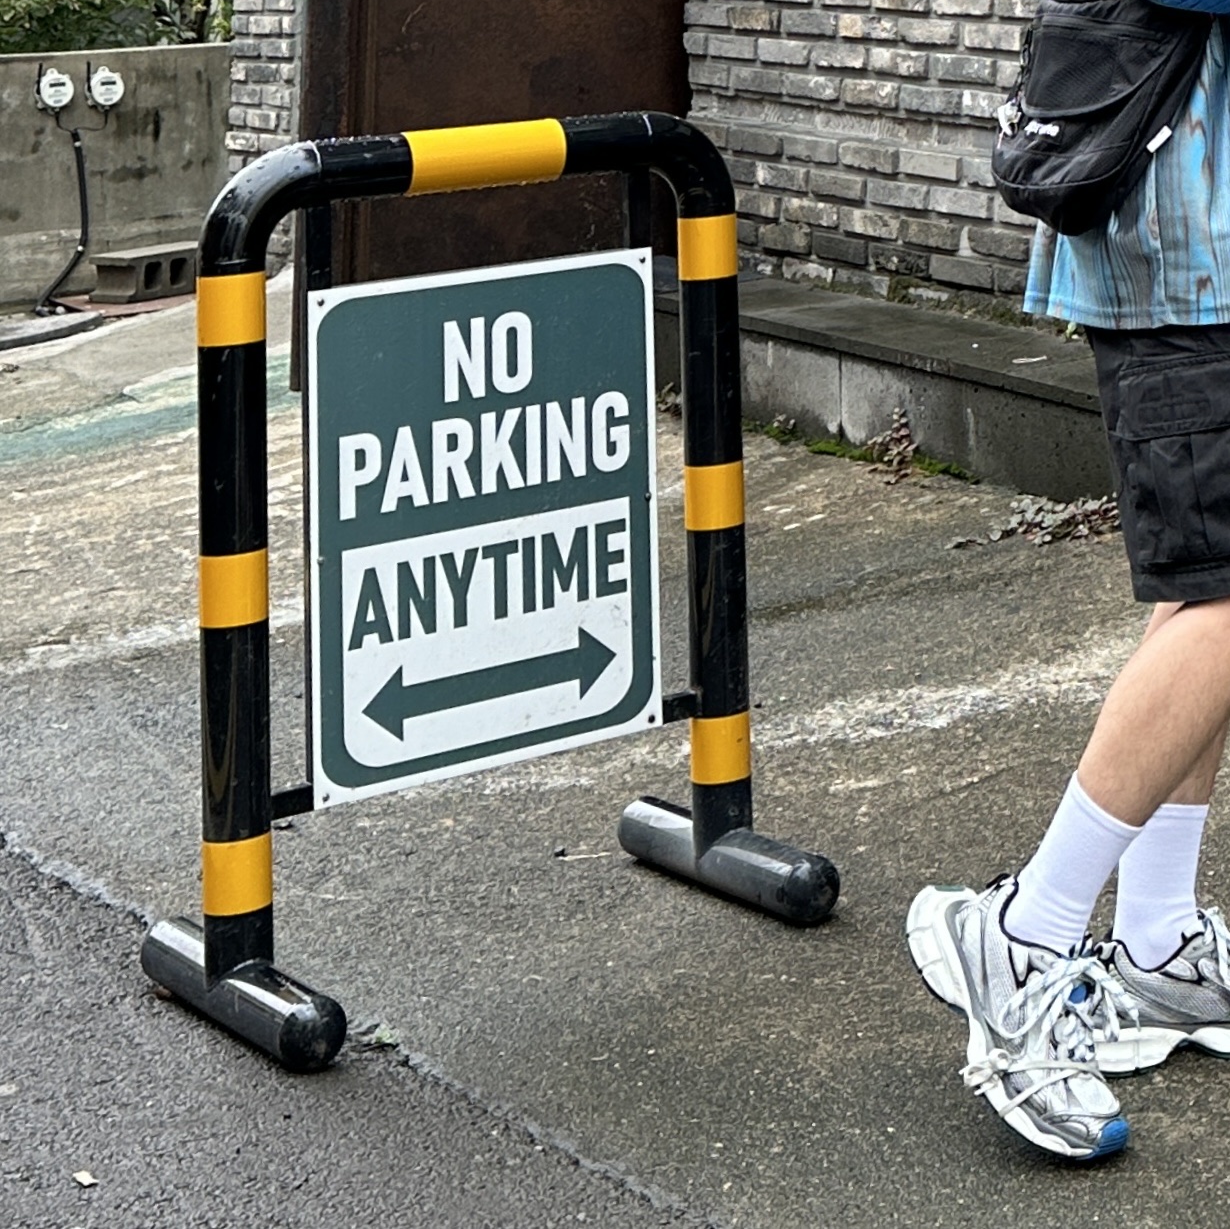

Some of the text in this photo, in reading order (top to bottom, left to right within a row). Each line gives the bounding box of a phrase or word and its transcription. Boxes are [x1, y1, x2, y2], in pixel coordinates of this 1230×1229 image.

[443, 311, 533, 403] NO
[338, 390, 631, 522] PARKING
[347, 517, 628, 652] ANYTIME
